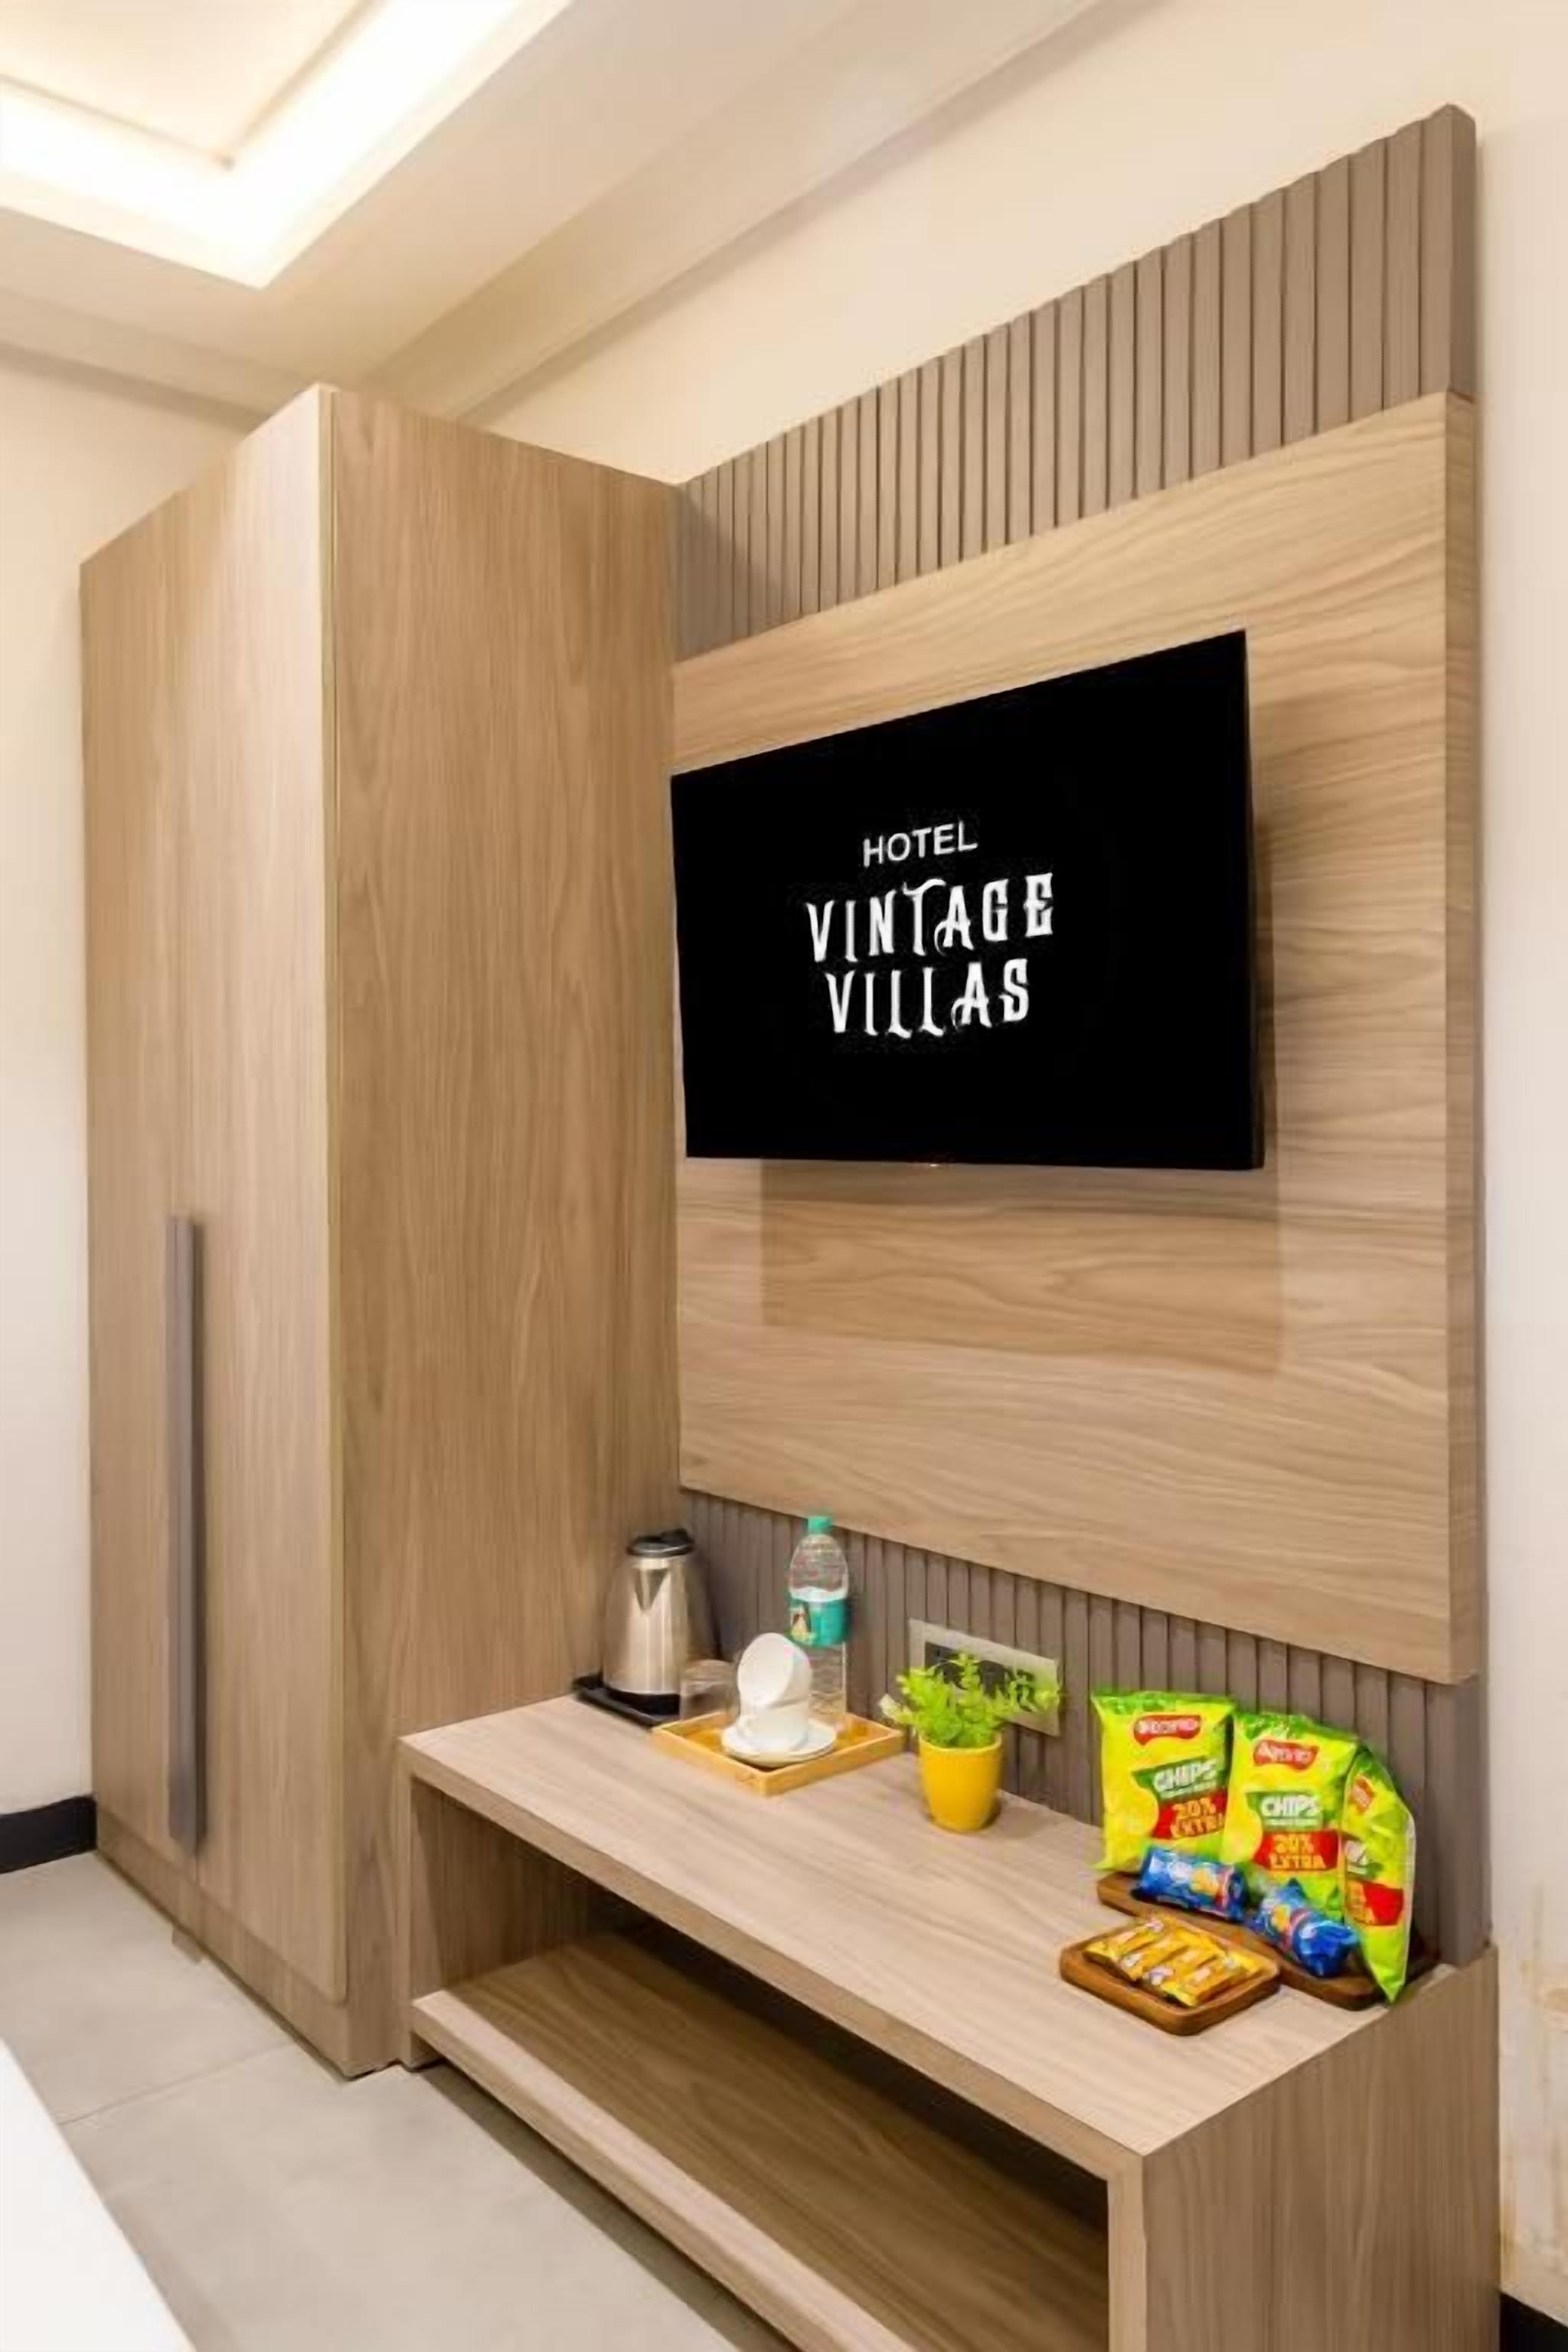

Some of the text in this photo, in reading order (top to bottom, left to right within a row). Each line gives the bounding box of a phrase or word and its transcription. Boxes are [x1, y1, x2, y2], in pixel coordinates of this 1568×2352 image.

[863, 821, 978, 867] HOTEL
[806, 873, 1053, 962] VINTAGE
[825, 959, 1029, 1039] VILLAS
[1153, 1759, 1217, 1792] CHIPS
[1261, 1795, 1321, 1817] CHIPS
